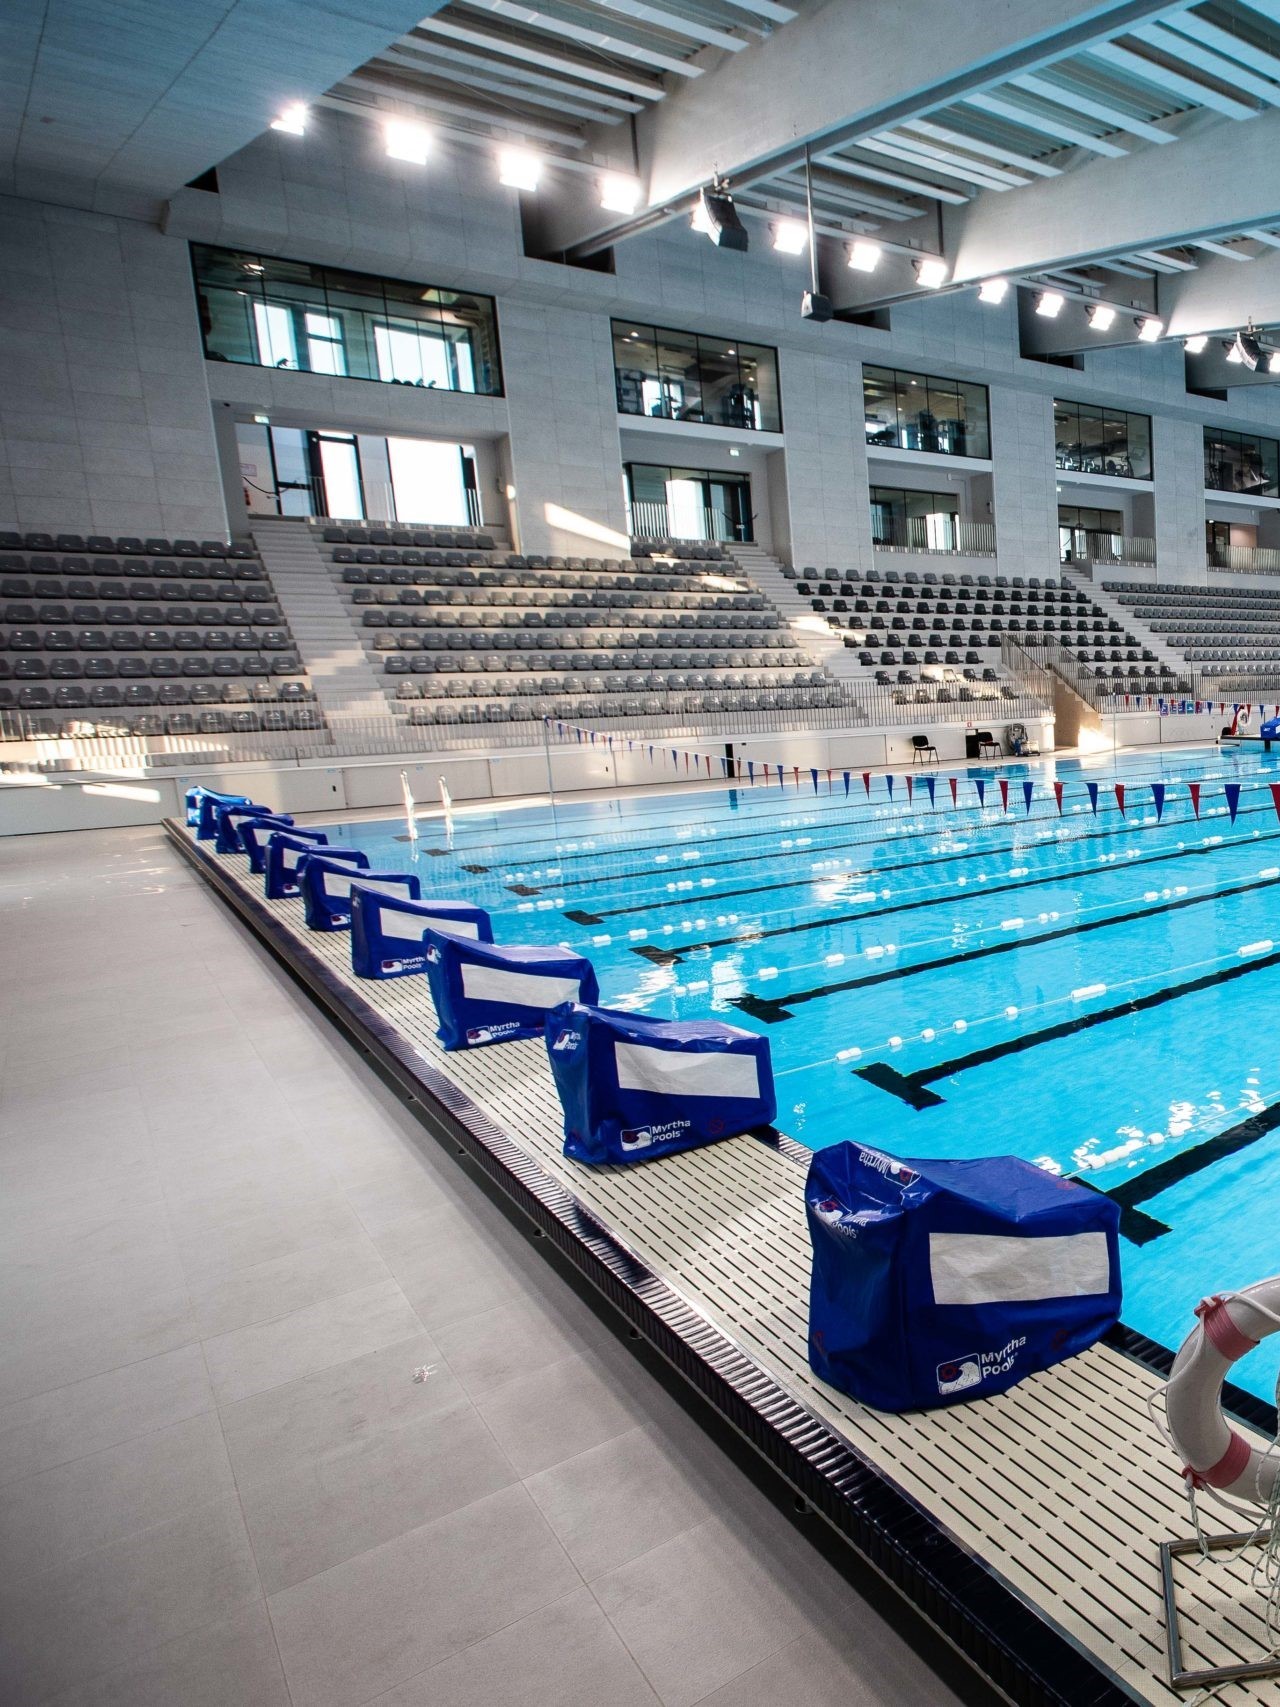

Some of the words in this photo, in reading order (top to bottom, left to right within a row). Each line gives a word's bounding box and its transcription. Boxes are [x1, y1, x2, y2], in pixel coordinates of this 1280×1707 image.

[490, 1021, 520, 1032] Myrtha
[651, 1120, 691, 1134] Myrtha
[652, 1129, 681, 1143] Pools
[981, 1336, 1027, 1364] Myrtha
[981, 1354, 1015, 1379] Pools
